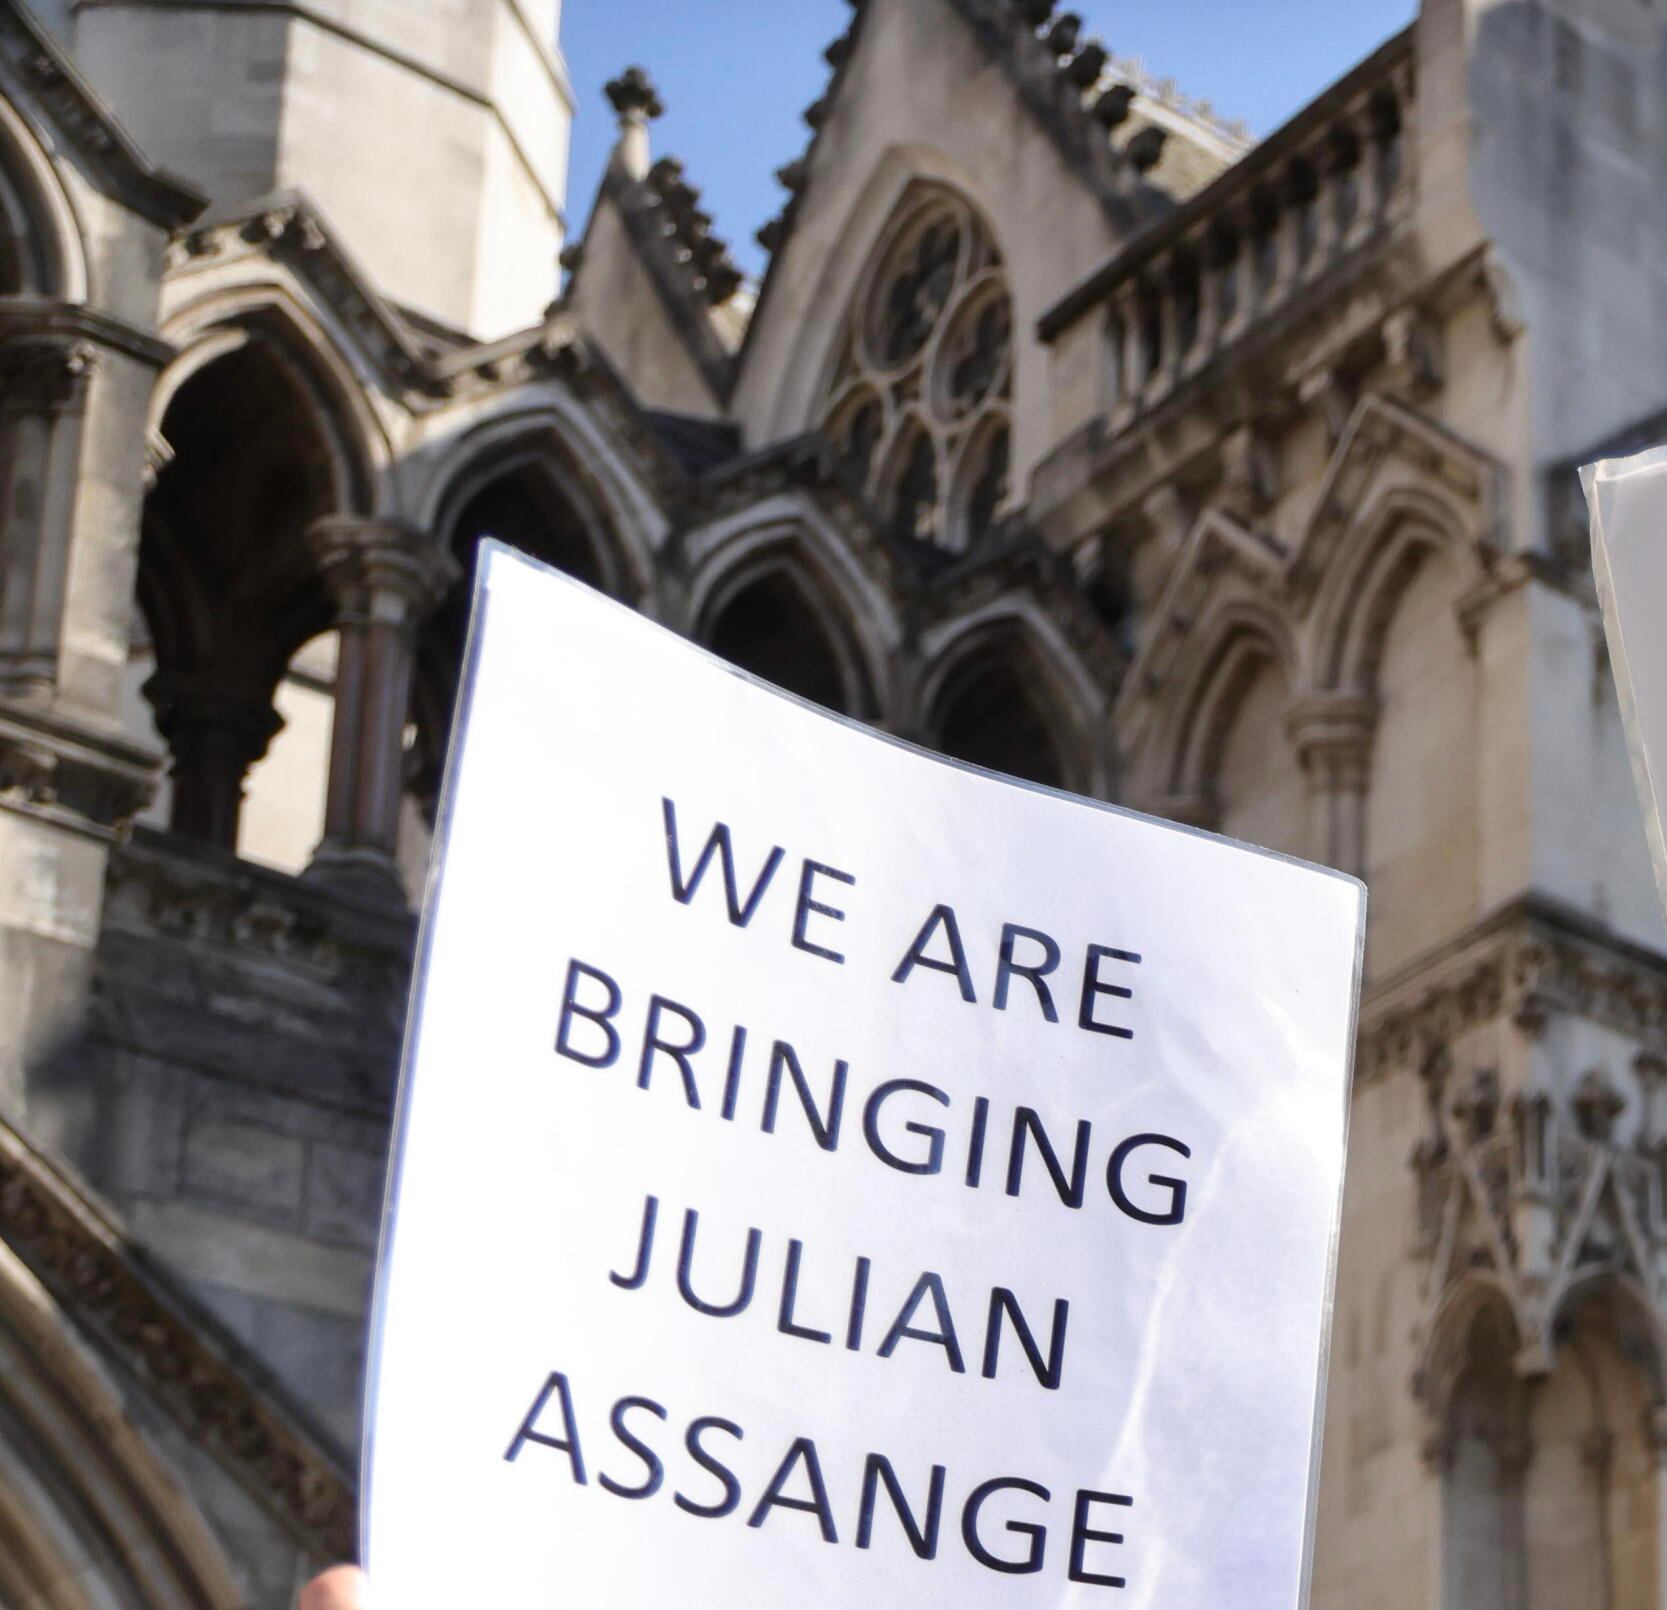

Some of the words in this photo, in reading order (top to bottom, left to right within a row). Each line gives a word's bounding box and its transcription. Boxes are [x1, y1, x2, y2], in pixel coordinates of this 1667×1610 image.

[659, 797, 857, 964] WE
[891, 903, 1143, 1041] ARE
[553, 958, 1193, 1229] BRINGING
[608, 1195, 1071, 1392] JULIAN
[504, 1371, 1135, 1590] ASSANGE
